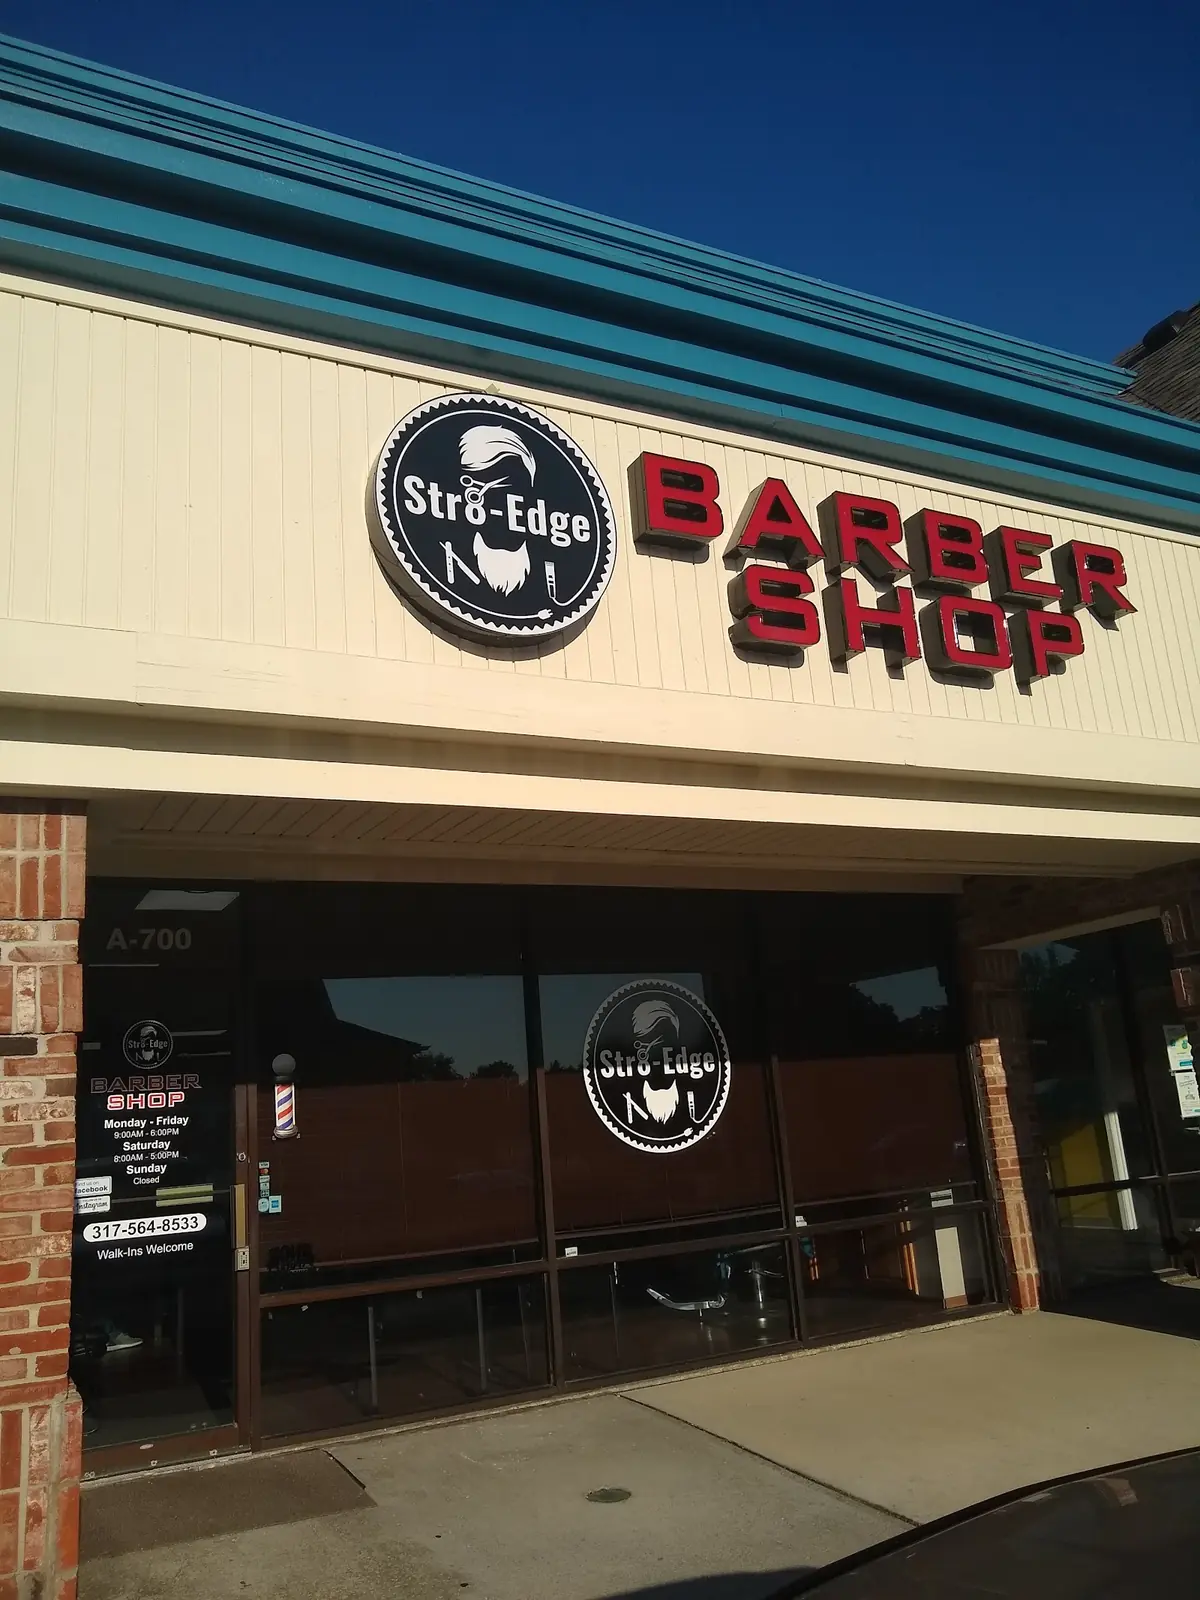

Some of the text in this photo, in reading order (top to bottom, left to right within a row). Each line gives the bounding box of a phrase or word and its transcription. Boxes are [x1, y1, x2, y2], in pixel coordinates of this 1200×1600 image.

[403, 475, 591, 548] Str8-Edge
[639, 451, 1137, 614] BARBER
[738, 564, 1085, 678] SHOP
[106, 927, 192, 951] A-700
[600, 1046, 716, 1079] Str8-Edge
[90, 1073, 203, 1094] BARBER
[107, 1091, 185, 1111] SHOP
[104, 1118, 147, 1129] Monday
[156, 1115, 189, 1127] Friday
[113, 1130, 144, 1139] 9:00AM
[150, 1128, 179, 1137] 6:00PM
[122, 1140, 171, 1152] Saturday
[113, 1153, 144, 1163] 8:00AM
[150, 1151, 179, 1160] 5:00PM
[126, 1163, 167, 1175] Sunday
[133, 1176, 160, 1185] Closed
[92, 1216, 199, 1239] 317-564-8533
[97, 1242, 194, 1260] Walk-Ins Welcome
